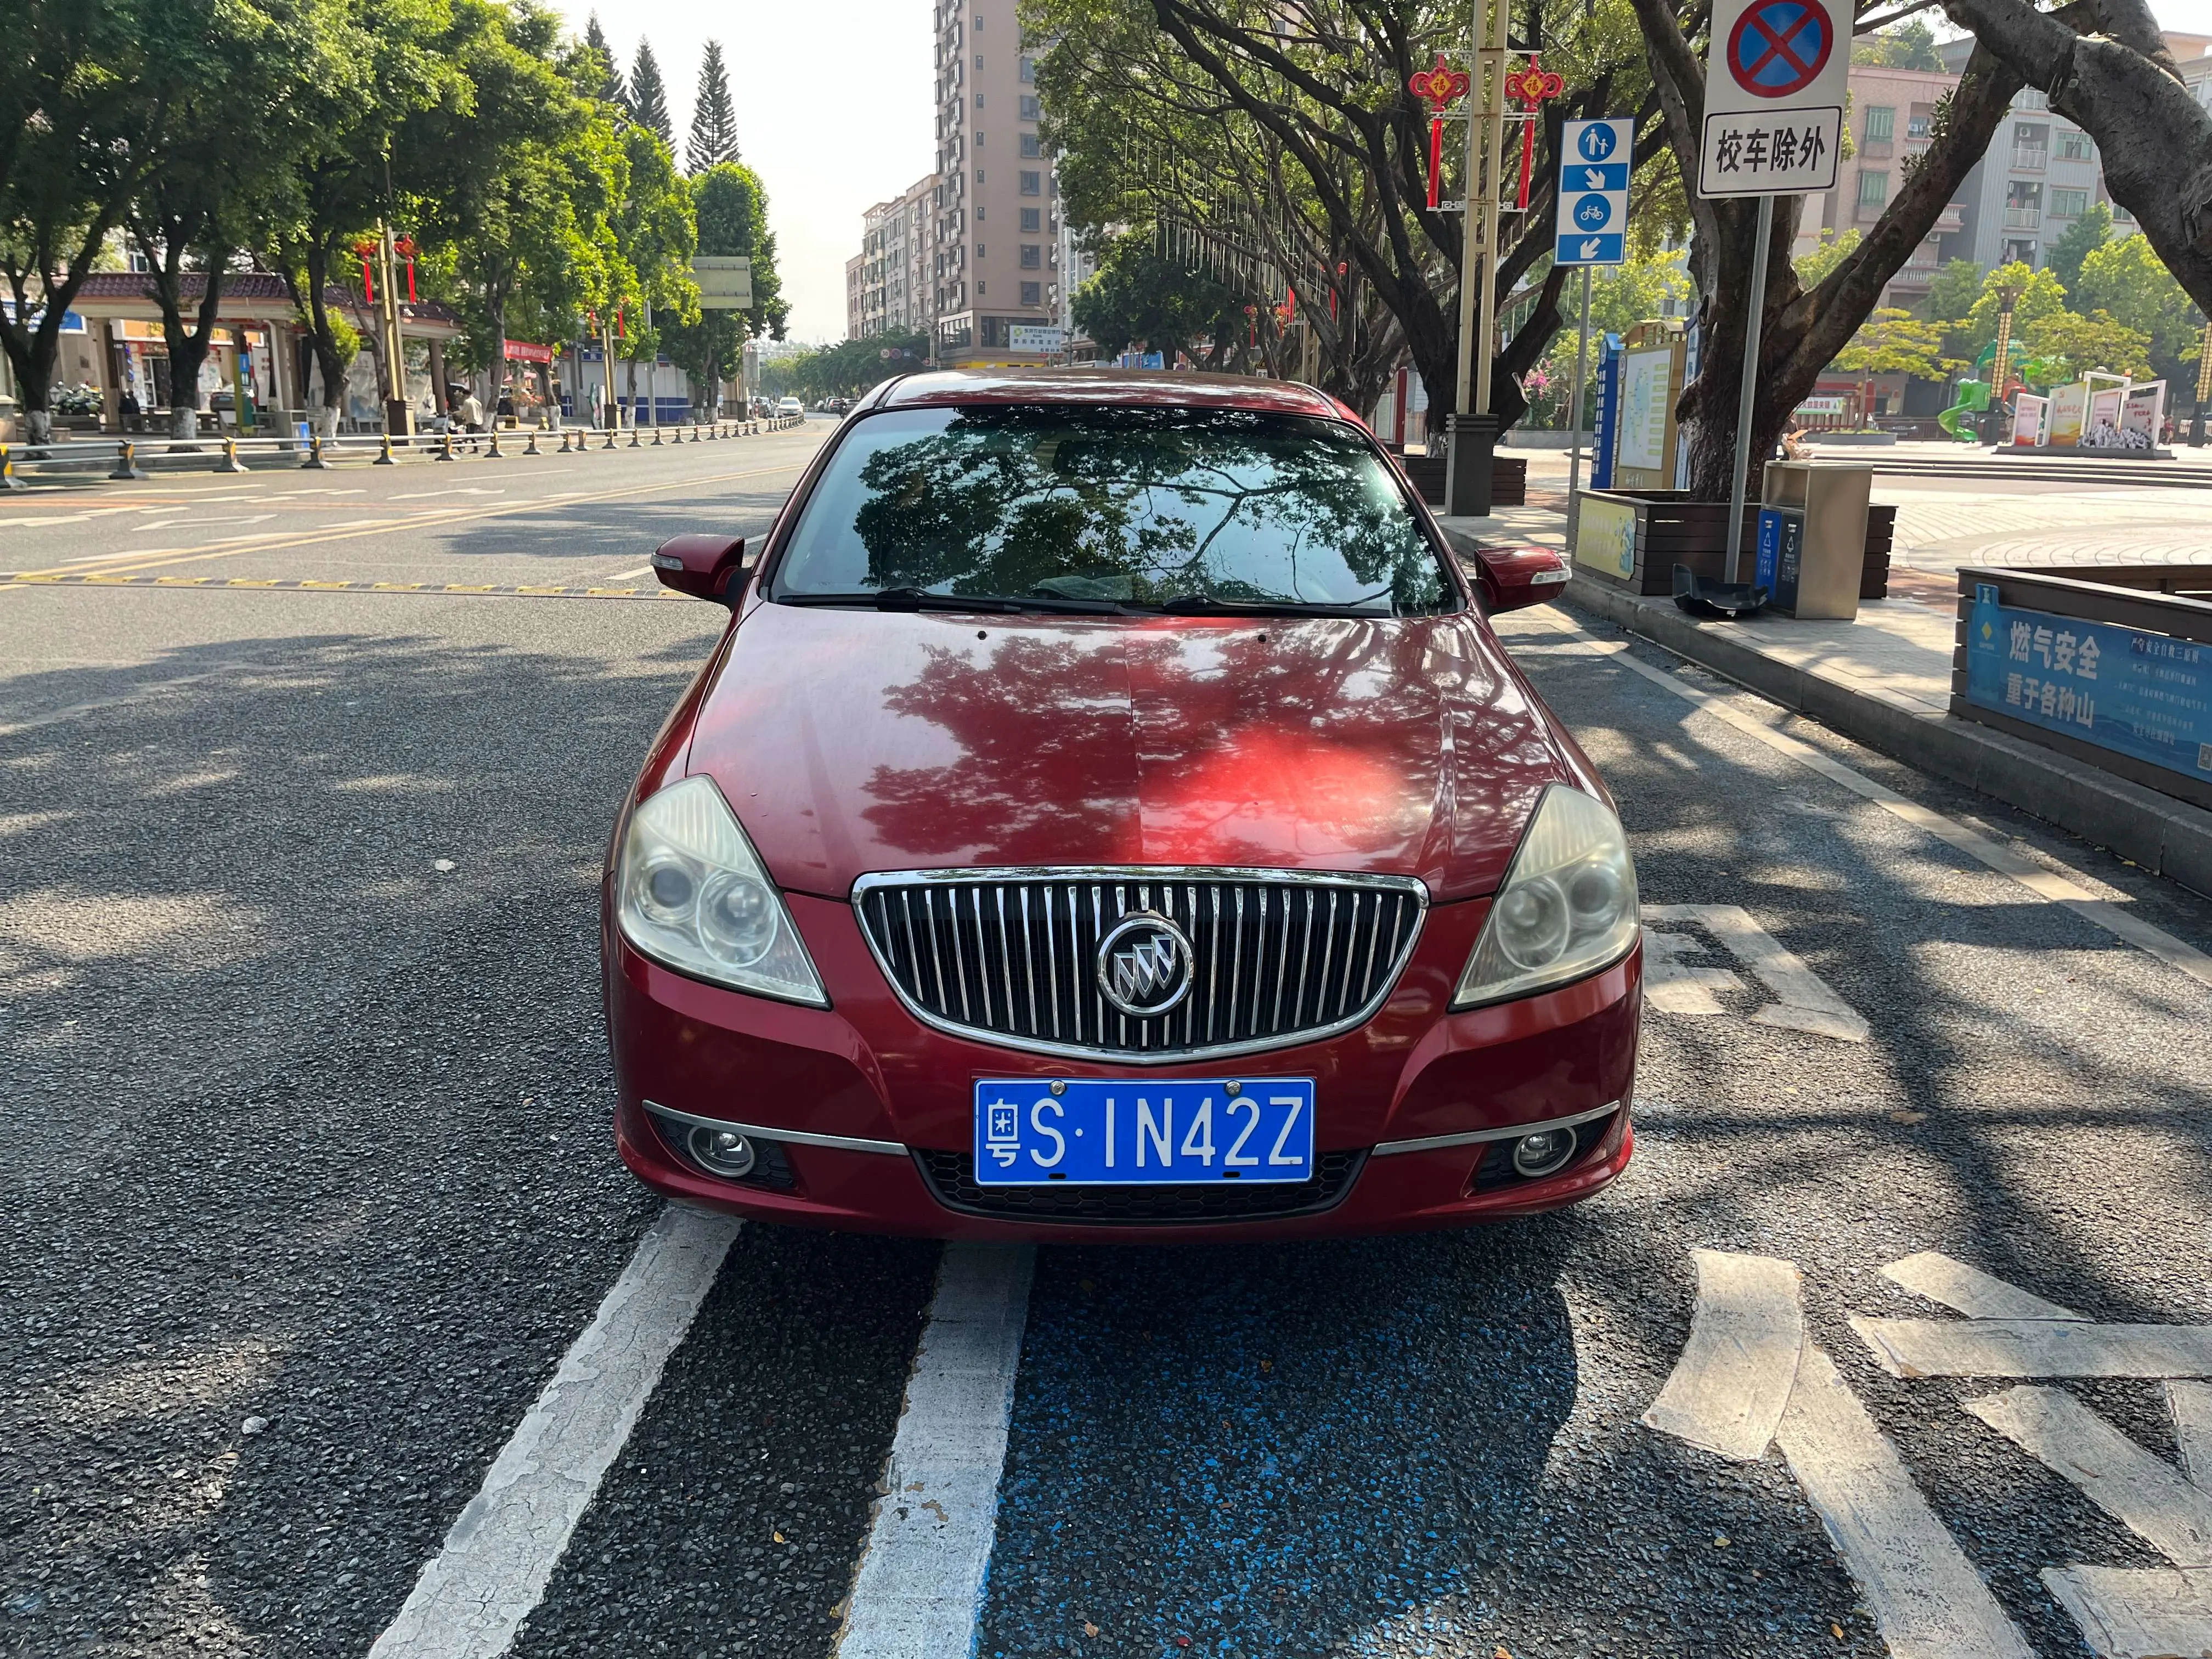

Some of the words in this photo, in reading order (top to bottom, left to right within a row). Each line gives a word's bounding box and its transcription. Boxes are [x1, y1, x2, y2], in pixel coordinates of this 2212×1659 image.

[1433, 78, 1446, 92] 福
[1526, 78, 1539, 92] 福
[1716, 125, 1826, 173] 校车除外
[2008, 620, 2101, 680] 燃气安全
[2005, 672, 2095, 729] 重于各种山
